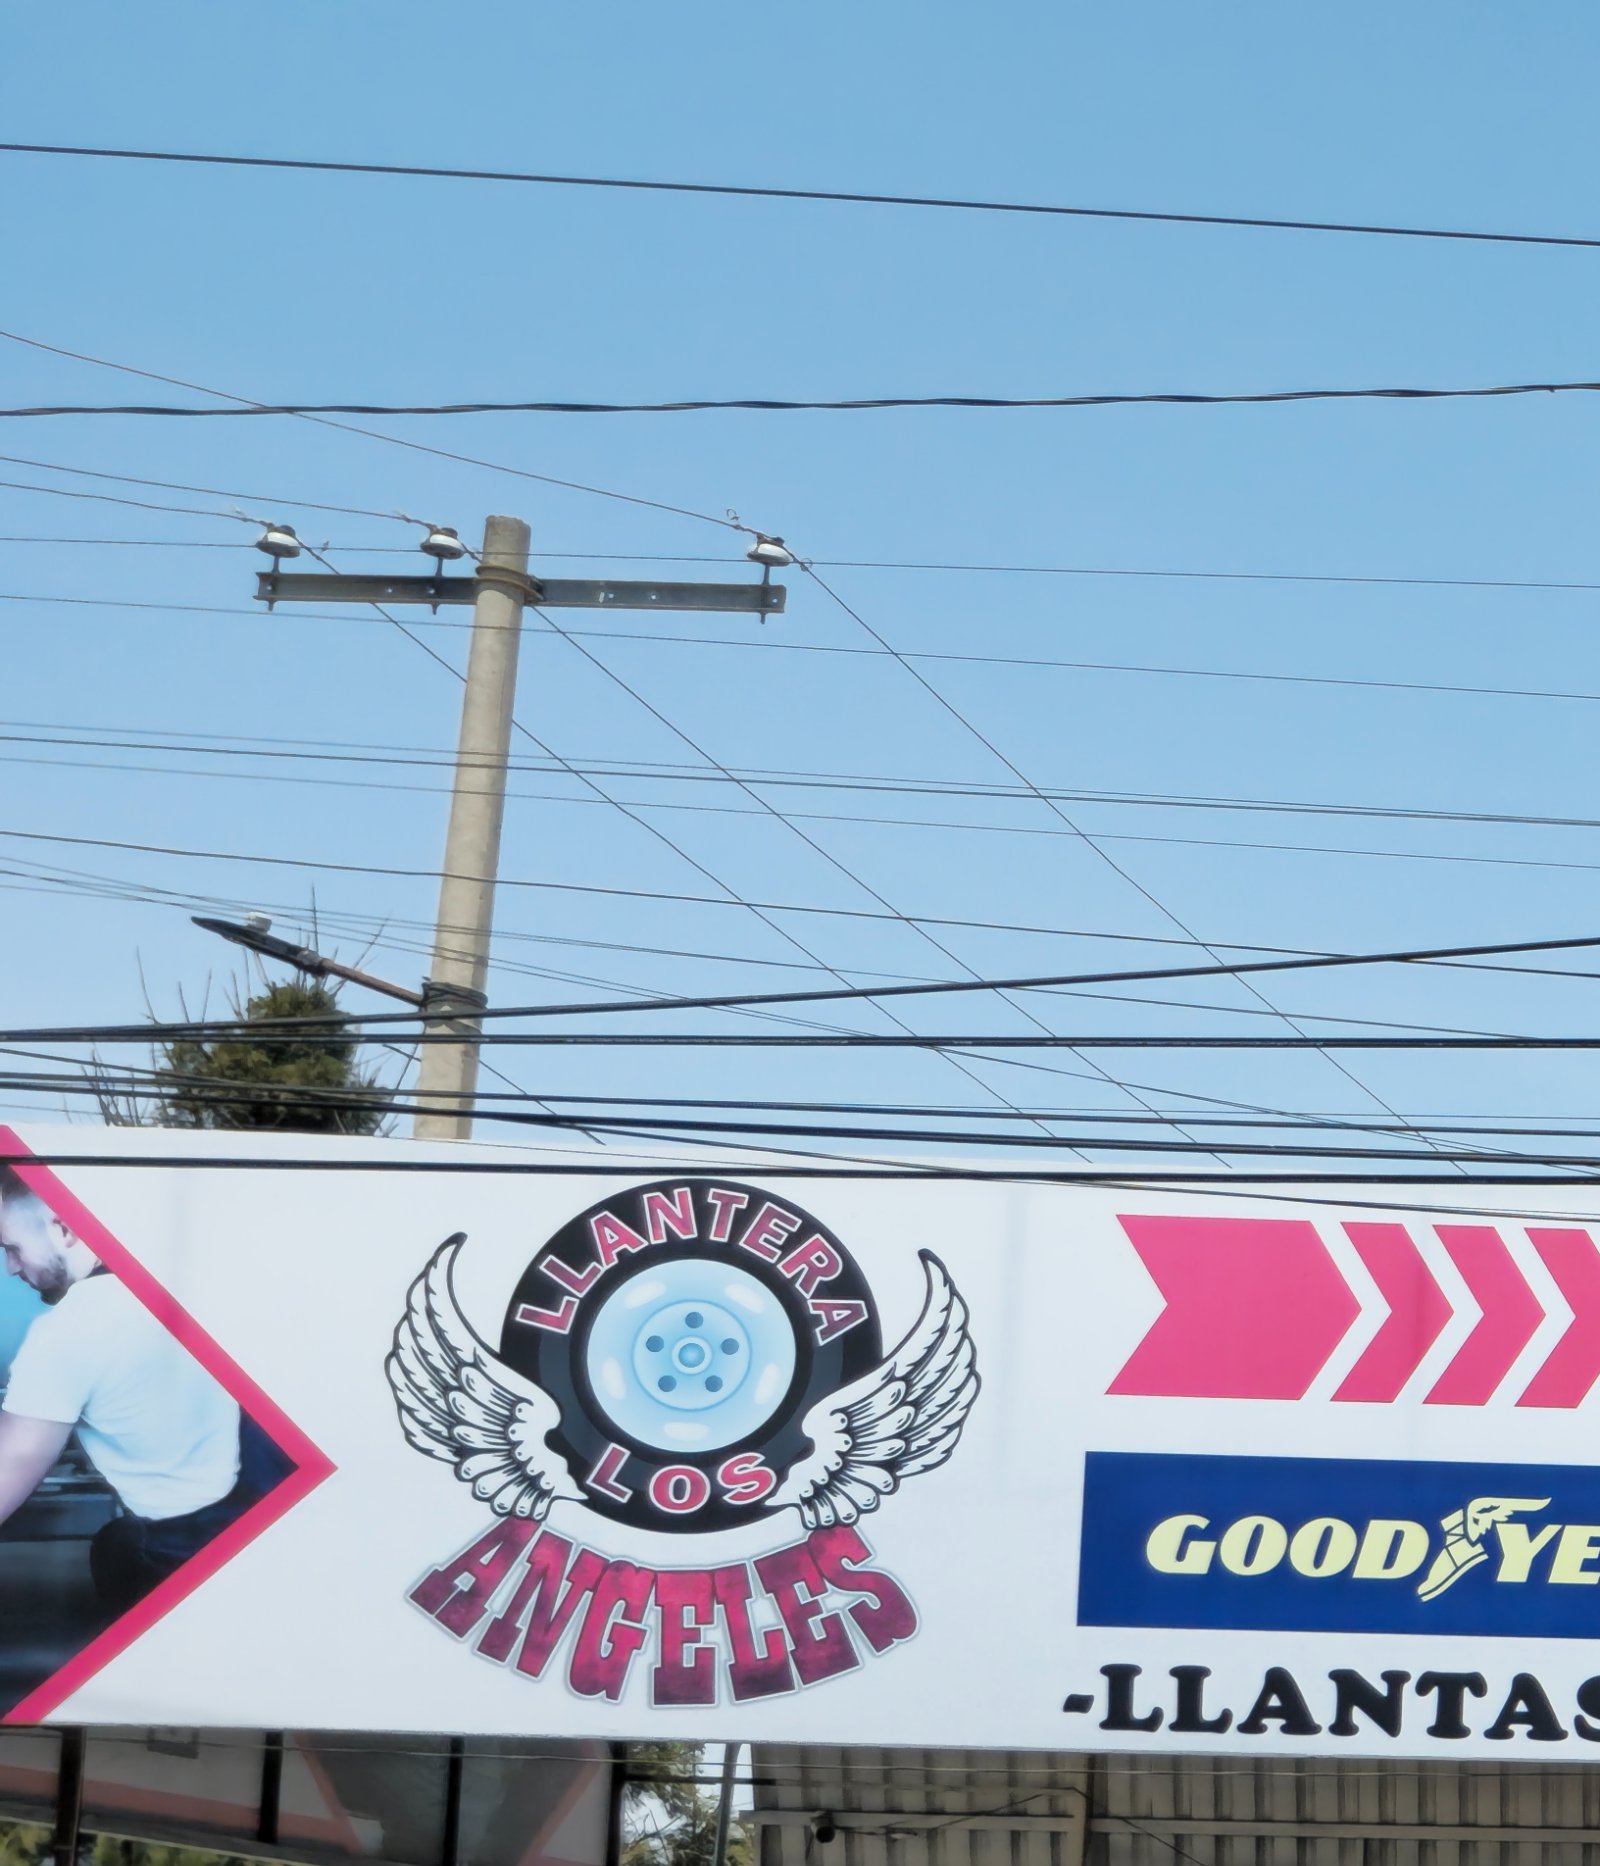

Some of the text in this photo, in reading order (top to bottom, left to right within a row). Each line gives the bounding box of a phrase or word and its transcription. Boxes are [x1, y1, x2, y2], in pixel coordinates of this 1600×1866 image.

[517, 1187, 872, 1346] LLANTERA
[585, 1443, 779, 1515] LOS
[407, 1515, 922, 1708] ANGELES
